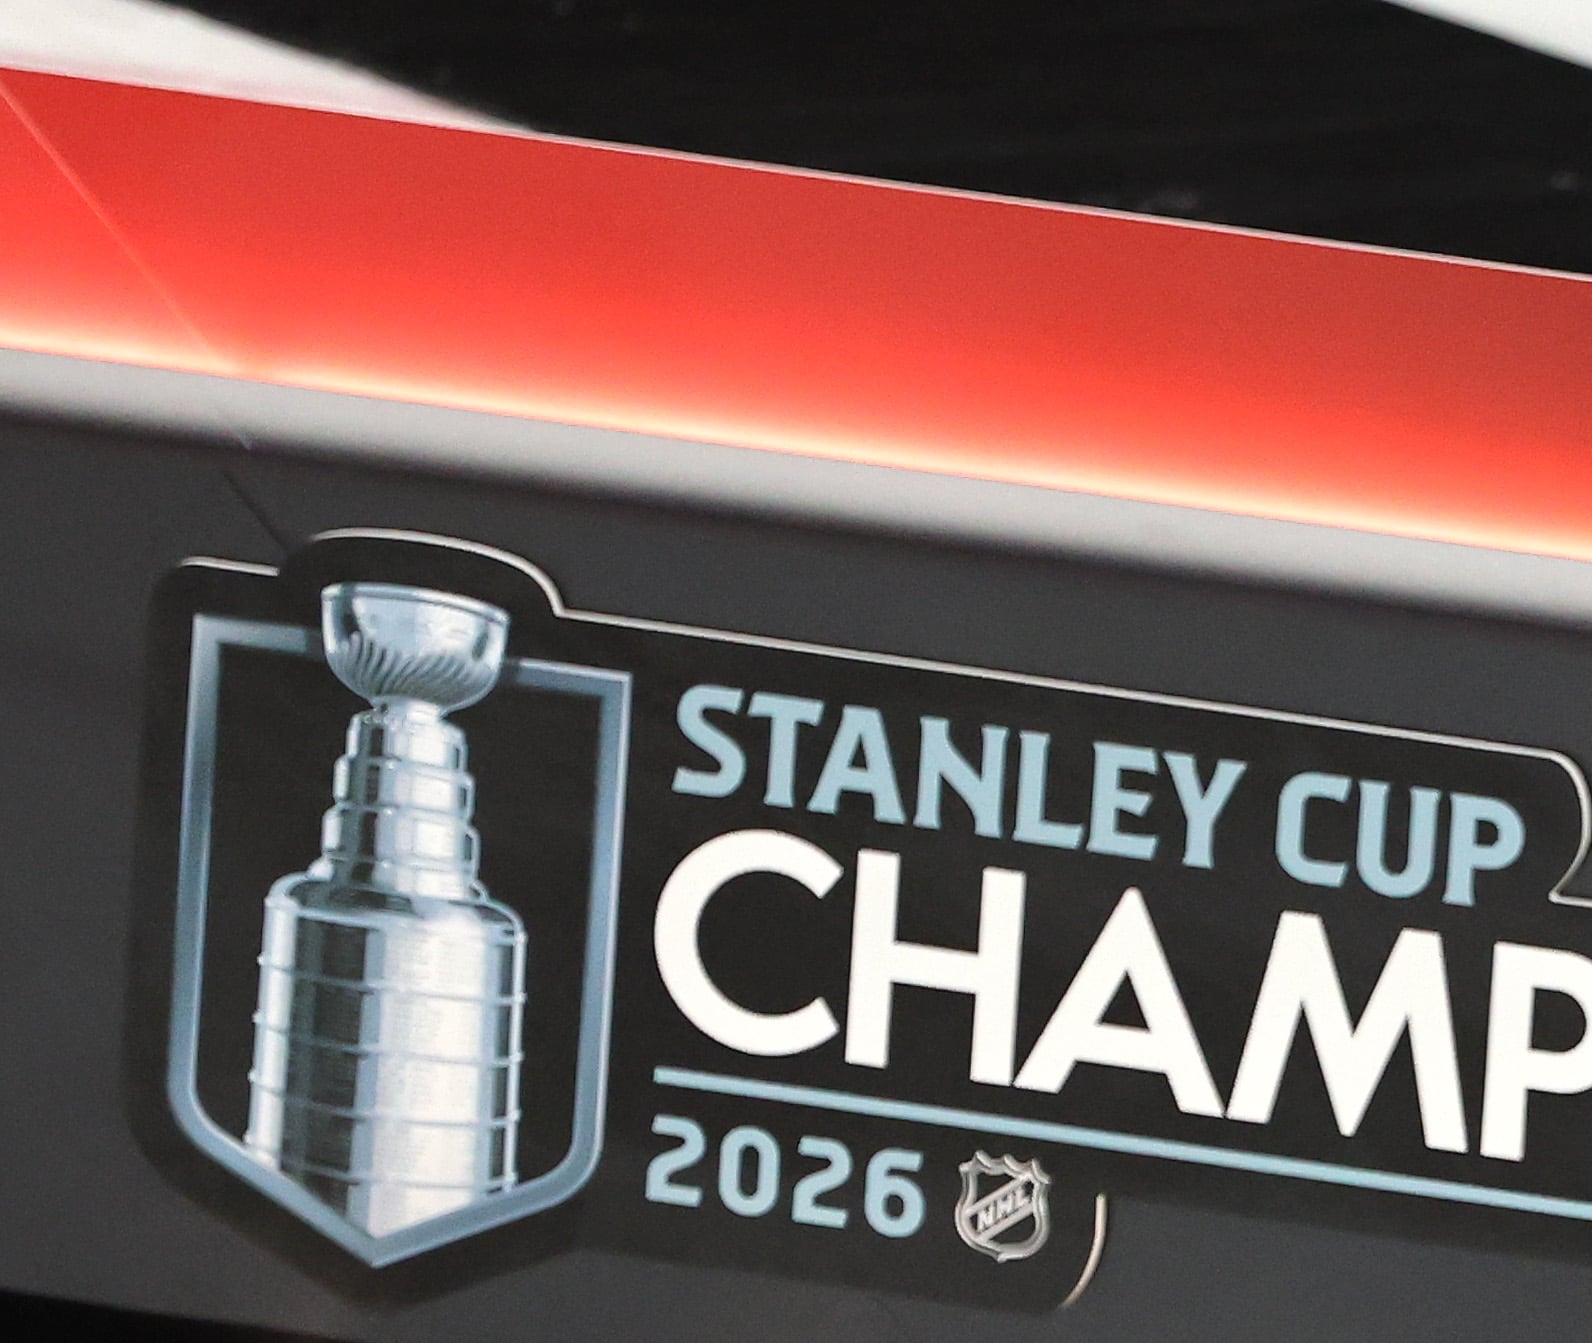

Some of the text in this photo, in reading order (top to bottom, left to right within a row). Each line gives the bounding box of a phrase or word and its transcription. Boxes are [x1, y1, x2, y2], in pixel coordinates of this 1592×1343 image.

[672, 684, 1526, 908] STANLEY CUP
[645, 1115, 926, 1240] 2026
[976, 1183, 1033, 1233] NHL
